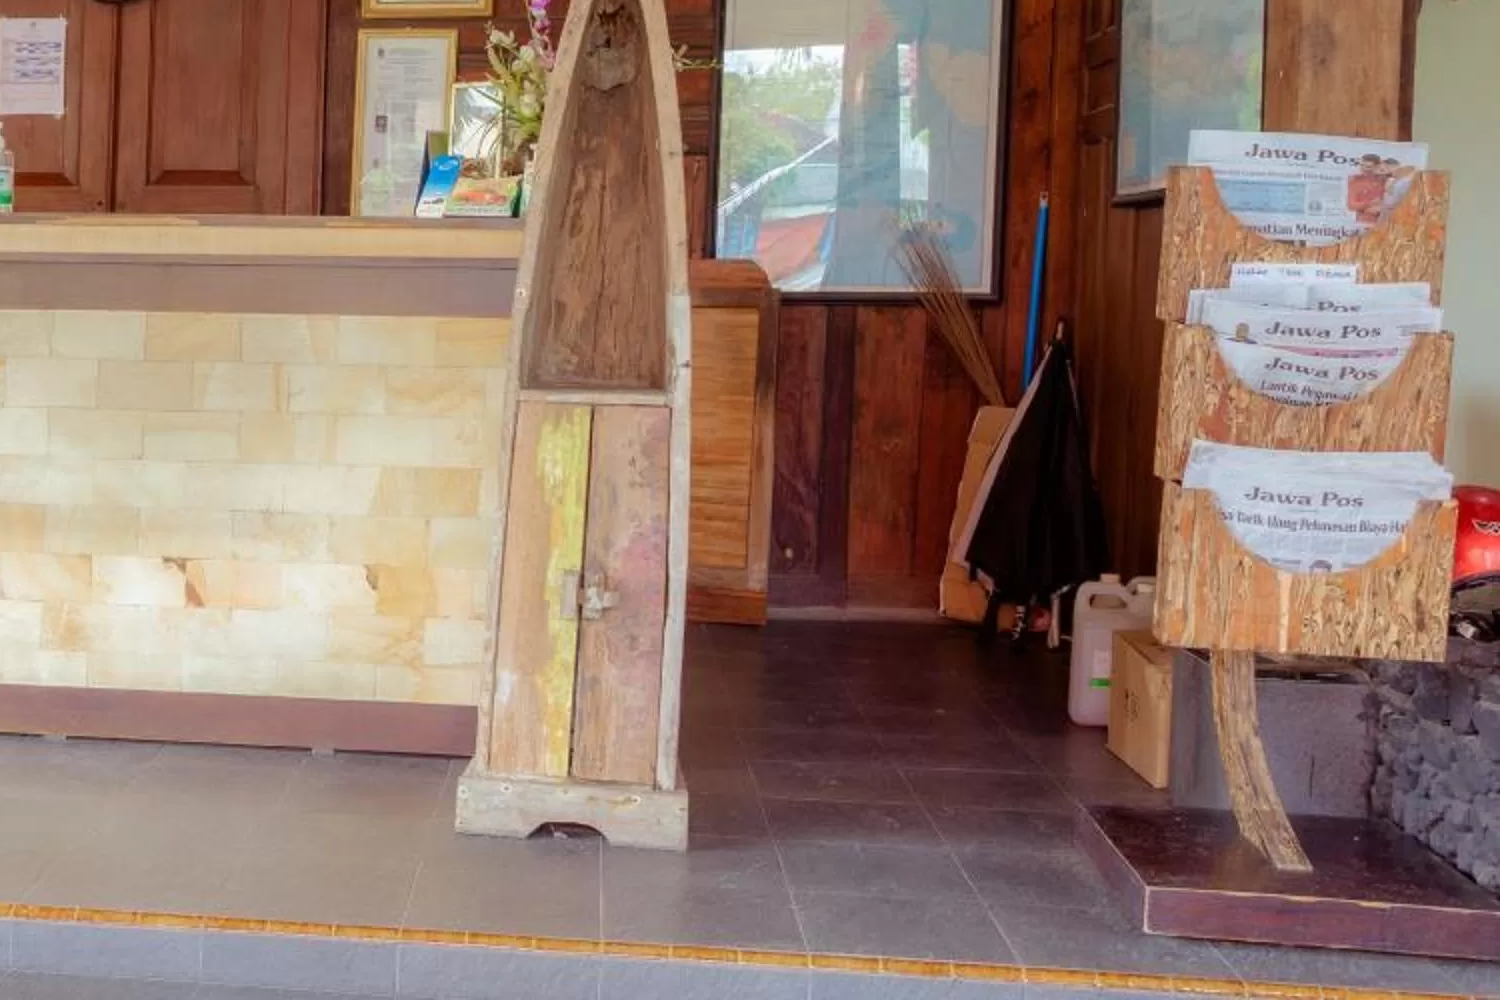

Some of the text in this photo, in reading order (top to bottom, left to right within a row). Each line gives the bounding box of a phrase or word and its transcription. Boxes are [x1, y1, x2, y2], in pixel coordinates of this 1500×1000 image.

[1244, 143, 1360, 166] Jawa Pos
[1264, 321, 1382, 340] Jawa Pos
[1263, 356, 1379, 381] Jawa Pos
[1243, 486, 1365, 508] Jawa Pos
